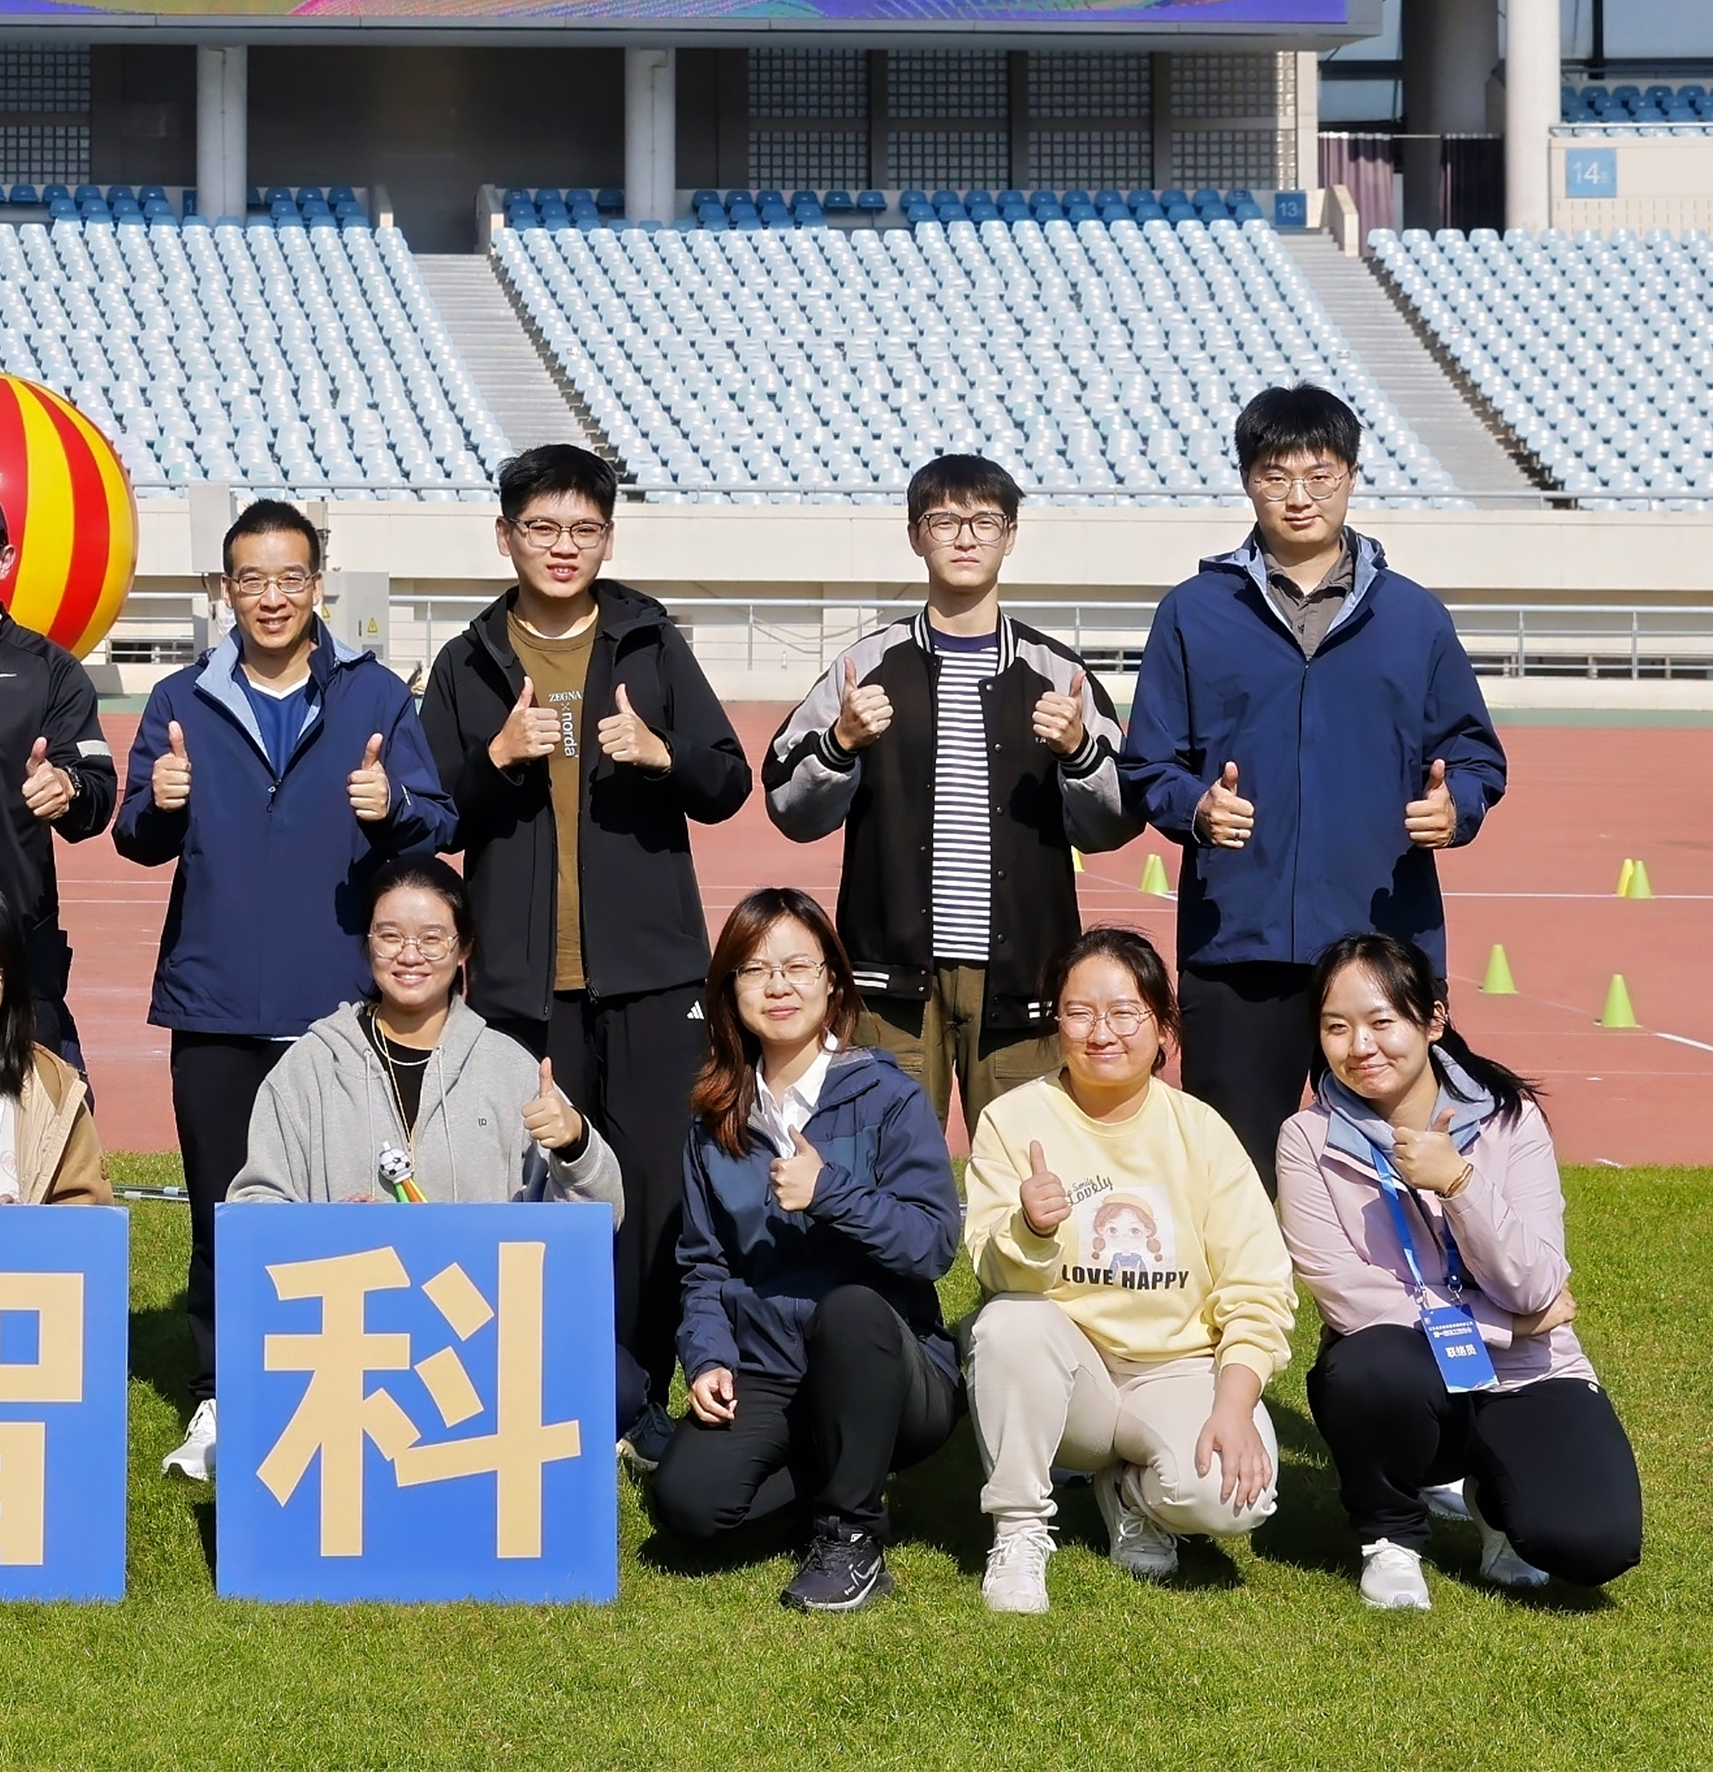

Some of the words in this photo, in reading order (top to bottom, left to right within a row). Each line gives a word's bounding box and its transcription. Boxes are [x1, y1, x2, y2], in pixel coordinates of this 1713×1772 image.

[548, 690, 583, 703] ZEGNA
[1061, 1264, 1114, 1286] LOVE
[1121, 1269, 1190, 1290] HAPPY
[1445, 1343, 1477, 1358] 联络员
[257, 1244, 581, 1558] 科
